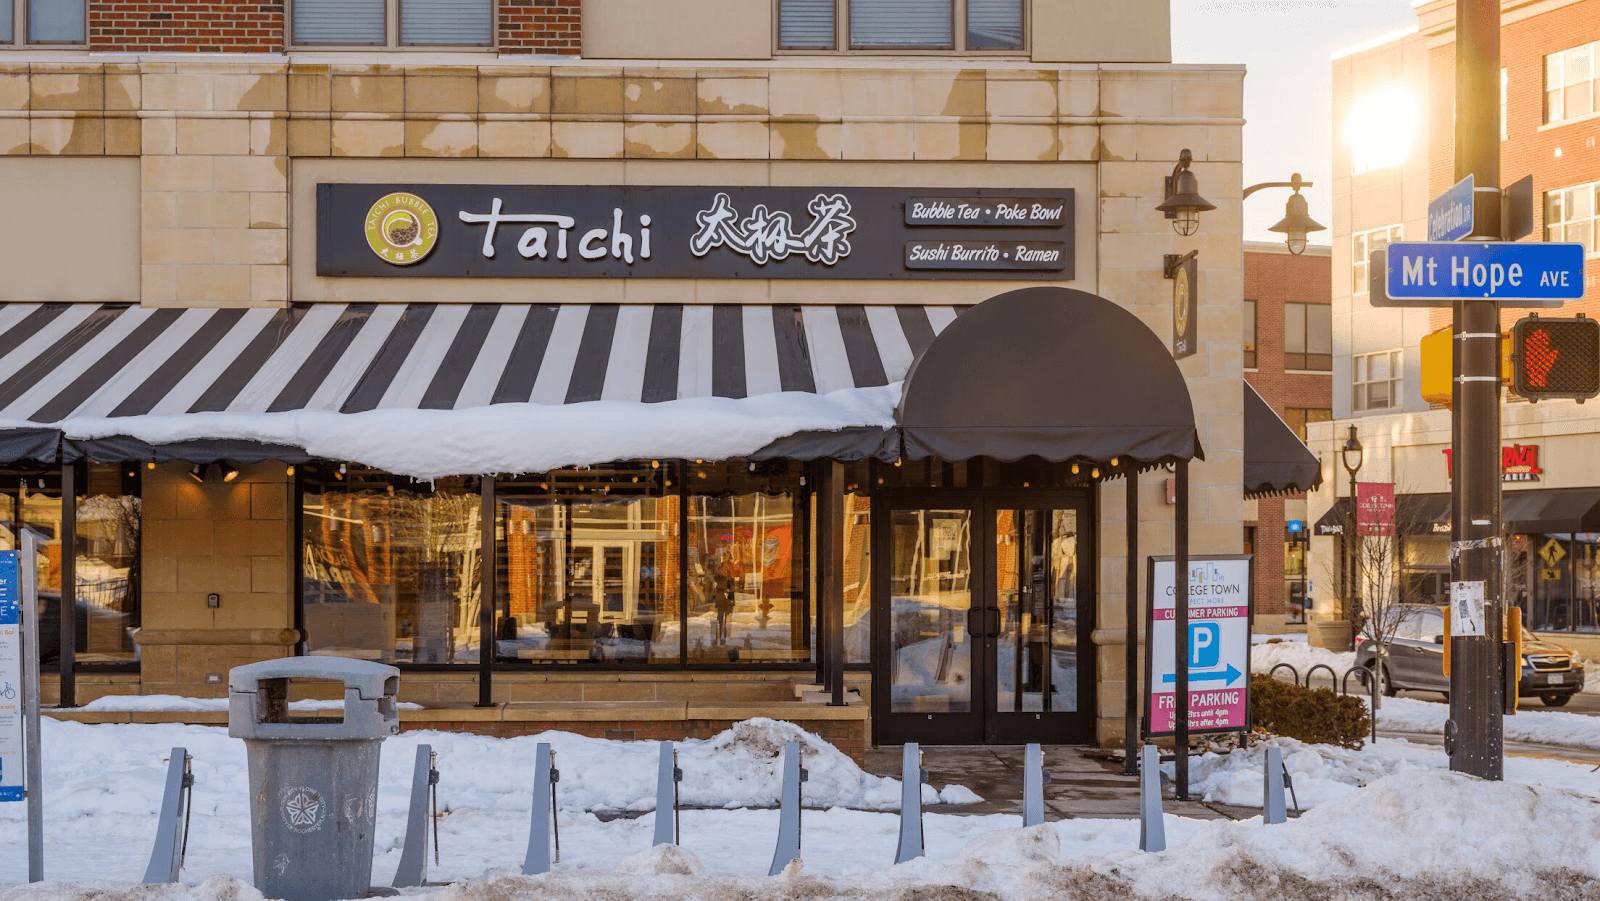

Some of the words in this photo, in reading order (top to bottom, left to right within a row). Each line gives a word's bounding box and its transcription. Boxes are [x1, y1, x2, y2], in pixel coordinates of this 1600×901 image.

[368, 200, 390, 230] TAICHI
[395, 196, 429, 215] BUBBLE
[426, 221, 435, 240] TEA
[911, 202, 955, 219] Bubble
[957, 204, 980, 219] Tea
[995, 203, 1027, 220] Poke
[1029, 203, 1063, 220] Bowl
[1429, 201, 1463, 242] Celebration
[1464, 204, 1471, 222] DR
[909, 243, 950, 261] Sushi
[950, 244, 1000, 261] Burrito
[1015, 245, 1059, 261] Ramen
[1402, 256, 1438, 286] Mt
[1451, 256, 1523, 294] Hope
[1540, 271, 1569, 287] AVE
[1166, 585, 1208, 596] CEGE
[1211, 584, 1240, 595] TOWN
[1165, 608, 1205, 619] CUMER
[1207, 607, 1239, 618] PARKING
[1193, 627, 1212, 664] P
[1159, 695, 1181, 709] FR
[1191, 692, 1239, 707] PARKING
[1200, 718, 1214, 727] after
[1215, 717, 1228, 727] 4pm
[1201, 709, 1214, 717] until
[1215, 708, 1228, 718] 4pm
